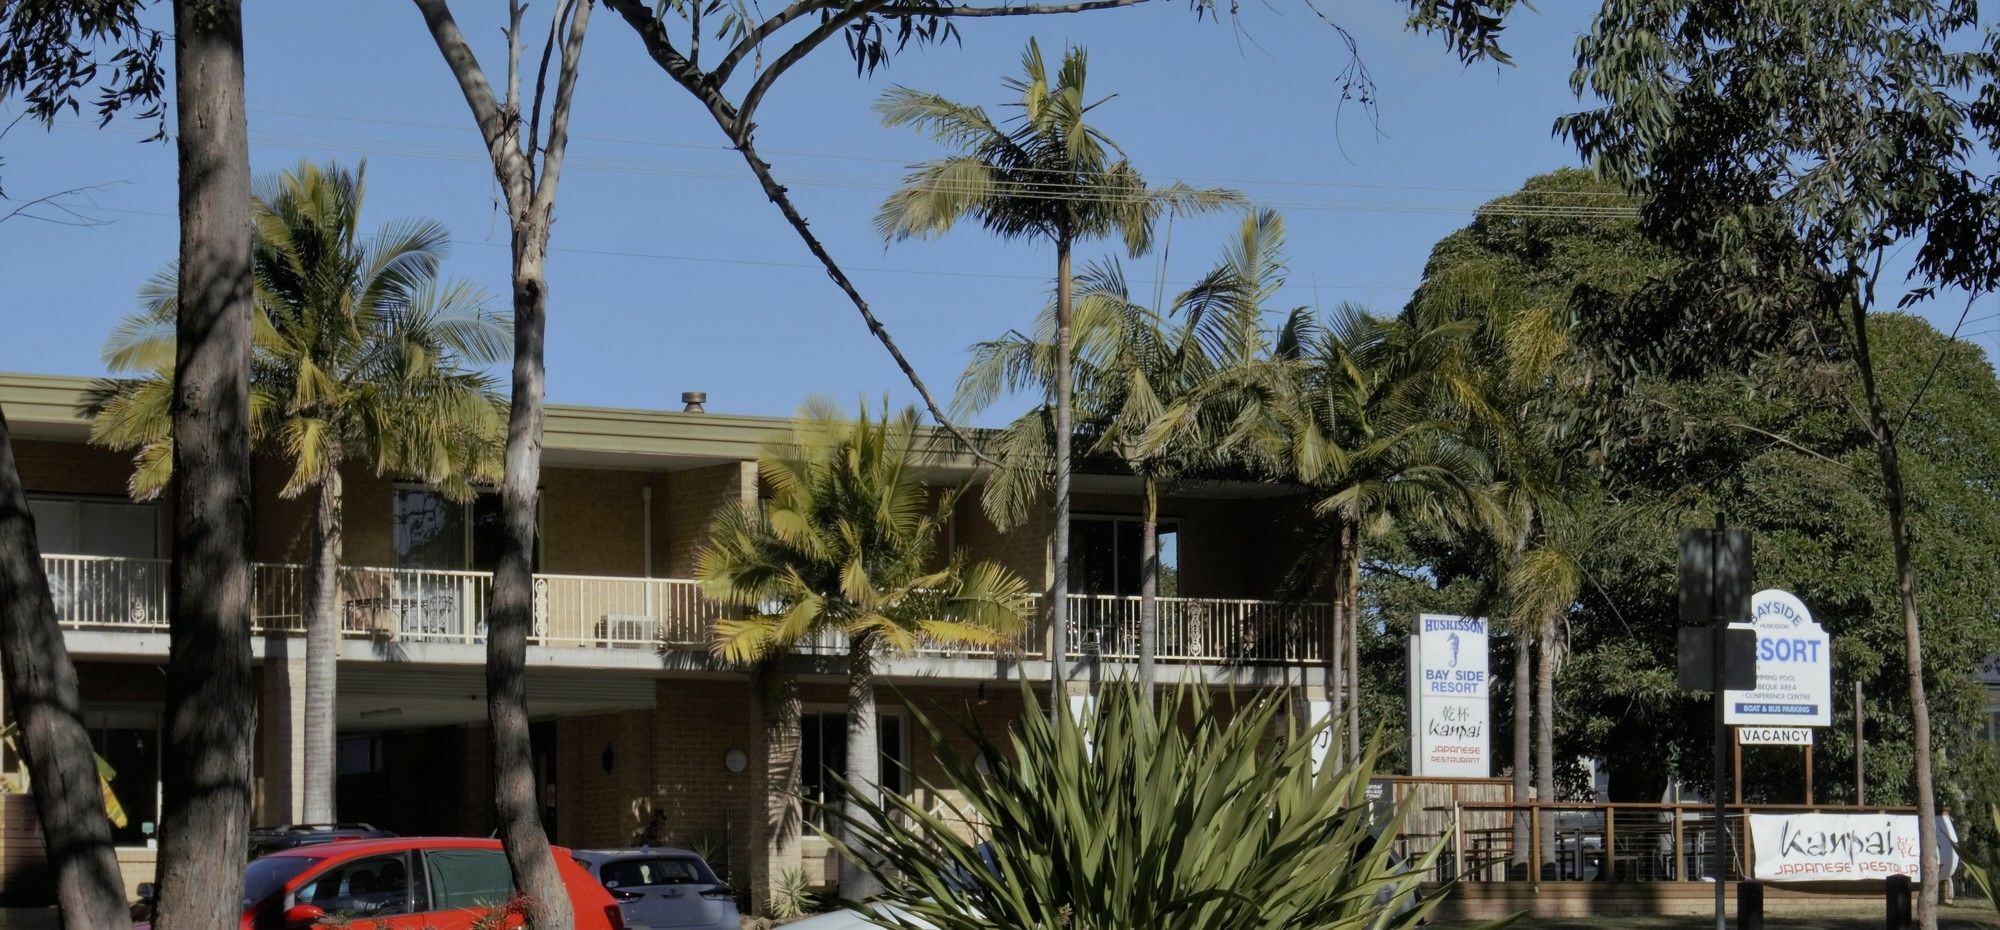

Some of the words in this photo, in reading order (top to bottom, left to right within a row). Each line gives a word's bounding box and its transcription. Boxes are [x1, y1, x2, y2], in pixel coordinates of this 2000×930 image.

[1751, 602, 1802, 626] BAYSIDE
[1424, 619, 1484, 635] HUSKISSON
[1756, 637, 1821, 662] SORT
[1426, 669, 1450, 681] BAY
[1455, 670, 1484, 682] SIDE
[1779, 674, 1796, 682] POOL
[1431, 682, 1479, 693] RESORT
[1787, 693, 1811, 701] CENTRE
[1743, 704, 1761, 712] BOAT
[1768, 705, 1781, 713] BUS
[1782, 705, 1810, 713] PARKING
[1743, 729, 1809, 742] VACANCY
[1432, 745, 1481, 755] JAPANESE
[1431, 756, 1481, 764] RESTAURANT
[1774, 862, 1852, 875] JAPANESE
[1859, 861, 1919, 875] RESTAUR
